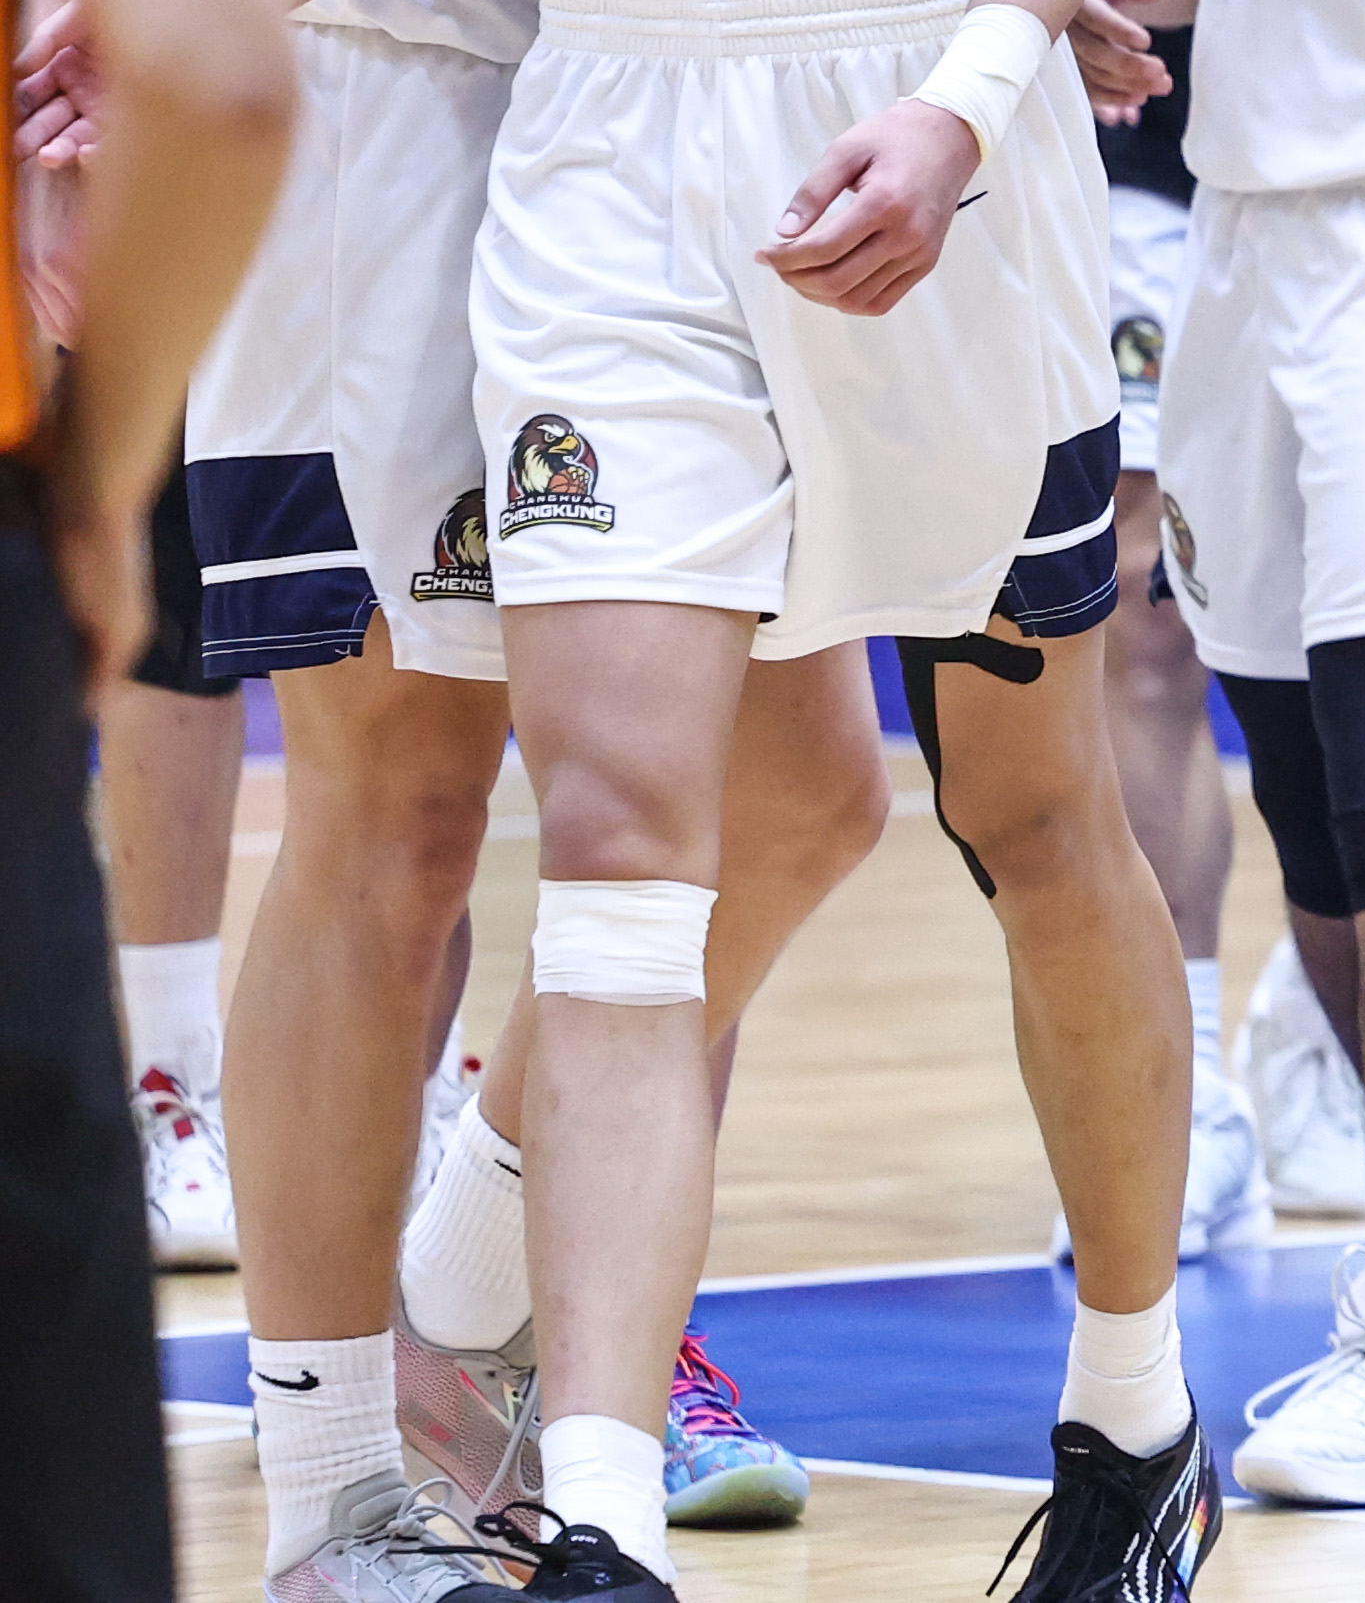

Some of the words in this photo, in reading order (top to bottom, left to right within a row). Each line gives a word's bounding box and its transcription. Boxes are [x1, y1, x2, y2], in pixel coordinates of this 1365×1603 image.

[509, 494, 594, 509] CHANGHUA
[501, 504, 613, 531] CHENGKUNG
[436, 568, 490, 578] CHAN
[414, 575, 493, 595] CHENG
